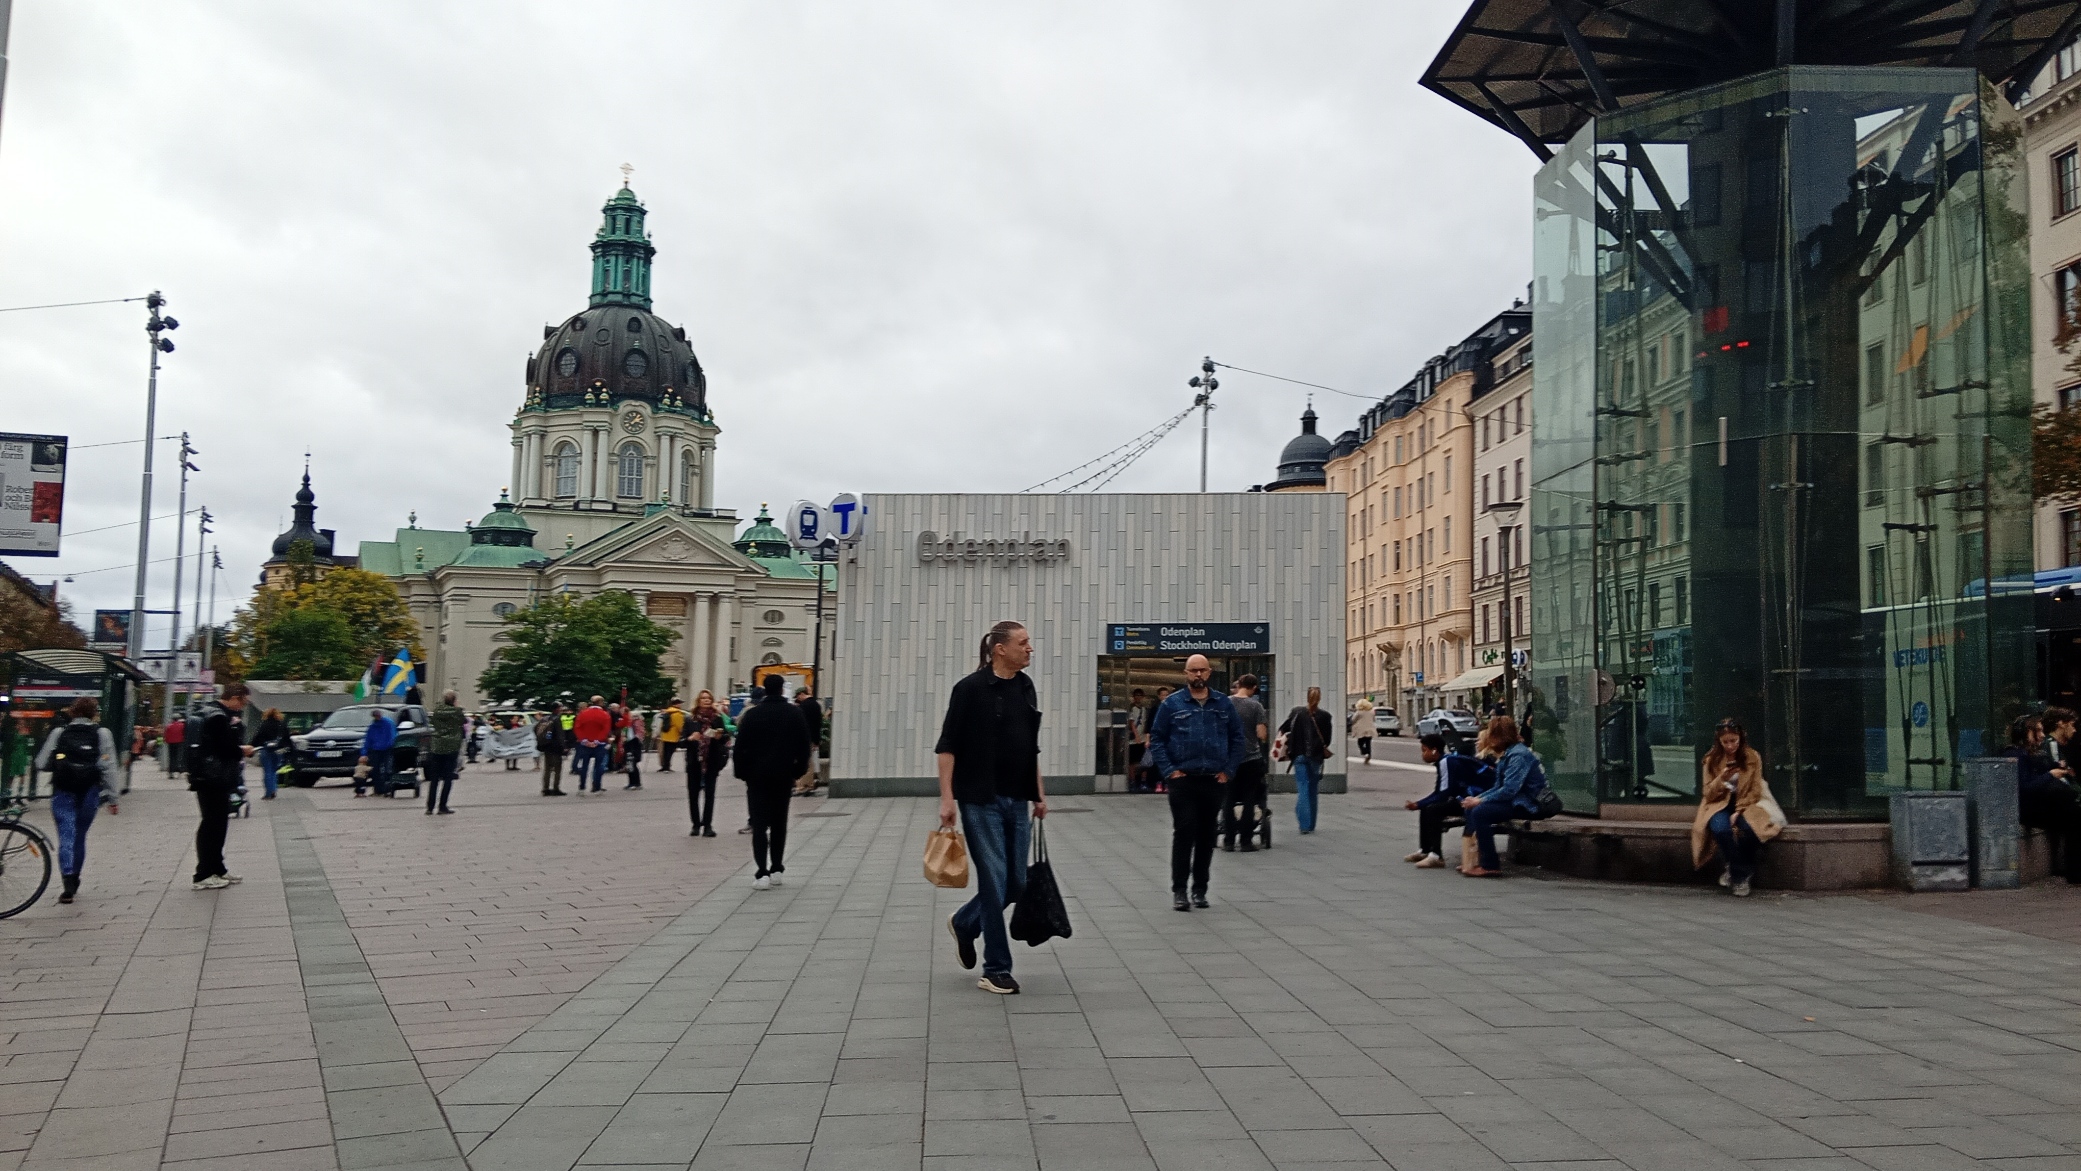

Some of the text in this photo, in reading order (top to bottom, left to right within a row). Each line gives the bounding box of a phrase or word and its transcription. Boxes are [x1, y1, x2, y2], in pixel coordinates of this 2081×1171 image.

[833, 502, 856, 535] T
[917, 530, 1071, 568] Odenplan
[1160, 627, 1206, 638] Odenplan
[1160, 640, 1257, 651] Stockholm Odenplan
